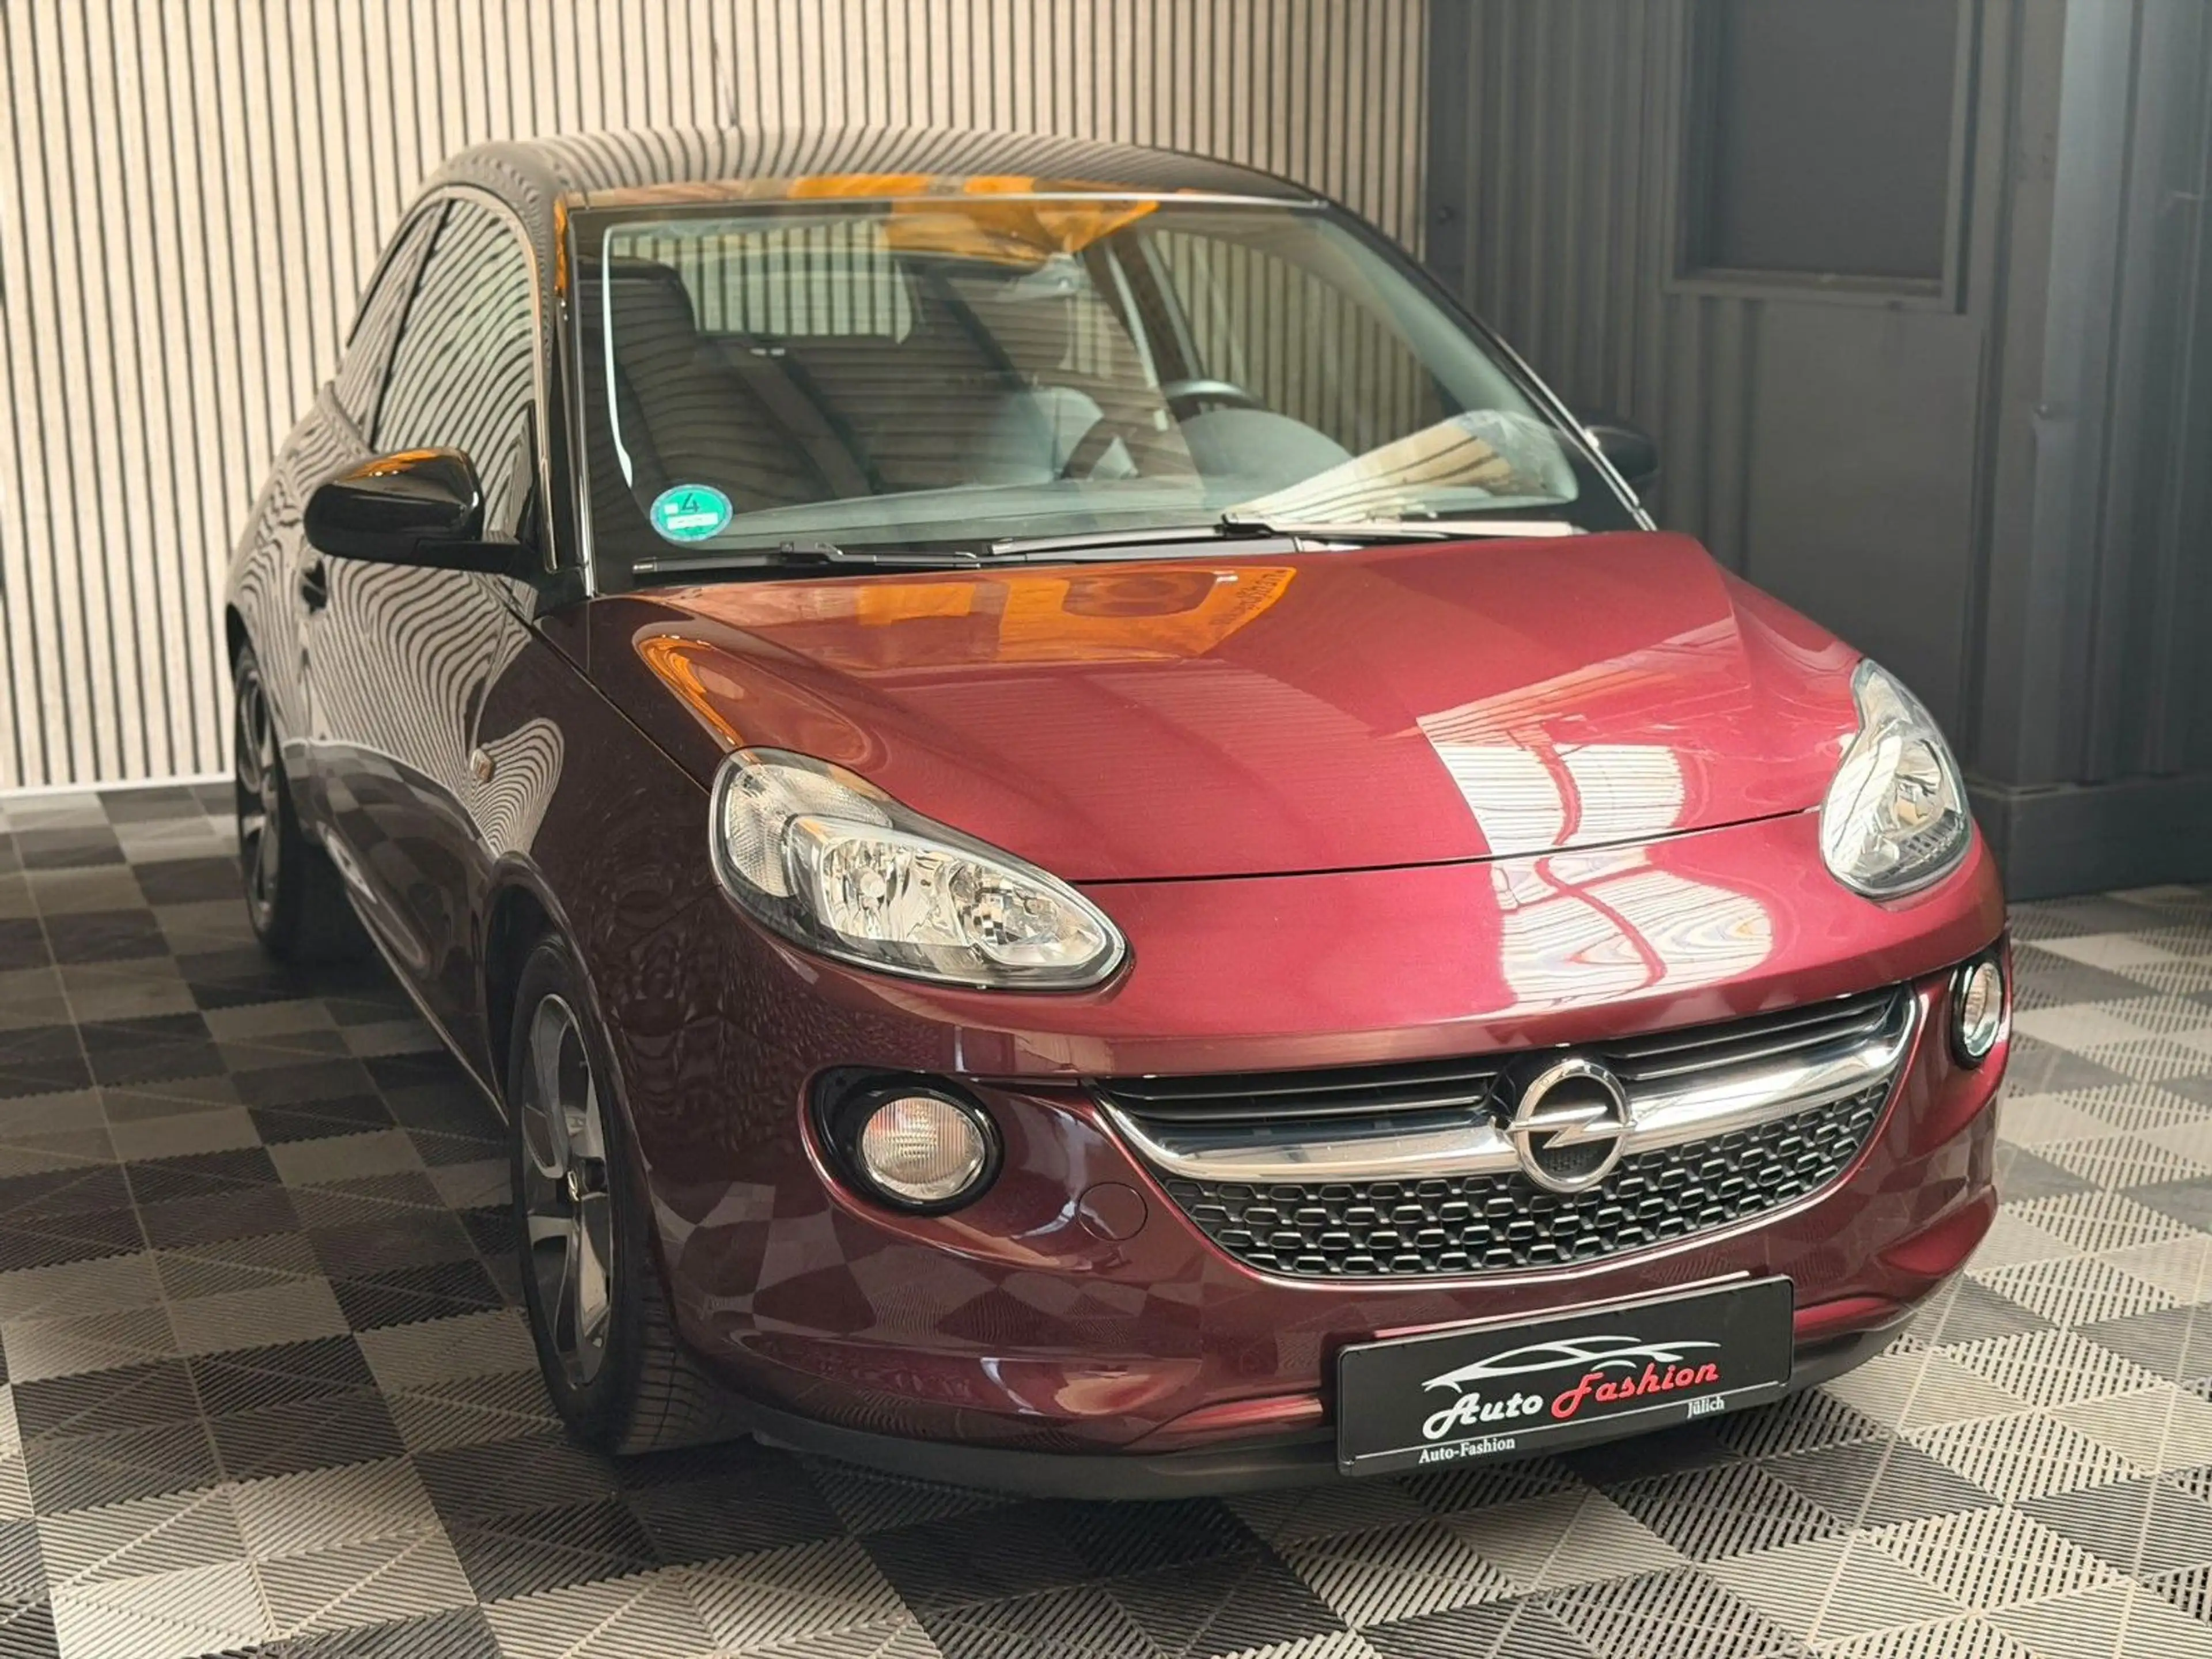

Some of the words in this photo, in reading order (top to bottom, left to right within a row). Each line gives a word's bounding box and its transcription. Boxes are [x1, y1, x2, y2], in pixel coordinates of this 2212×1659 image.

[681, 493, 699, 512] 4
[1422, 1392, 1543, 1440] Auto
[1551, 1362, 1719, 1418] Fashion
[1687, 1396, 1725, 1419] Jülich
[1418, 1437, 1516, 1464] Auto-Fashion
